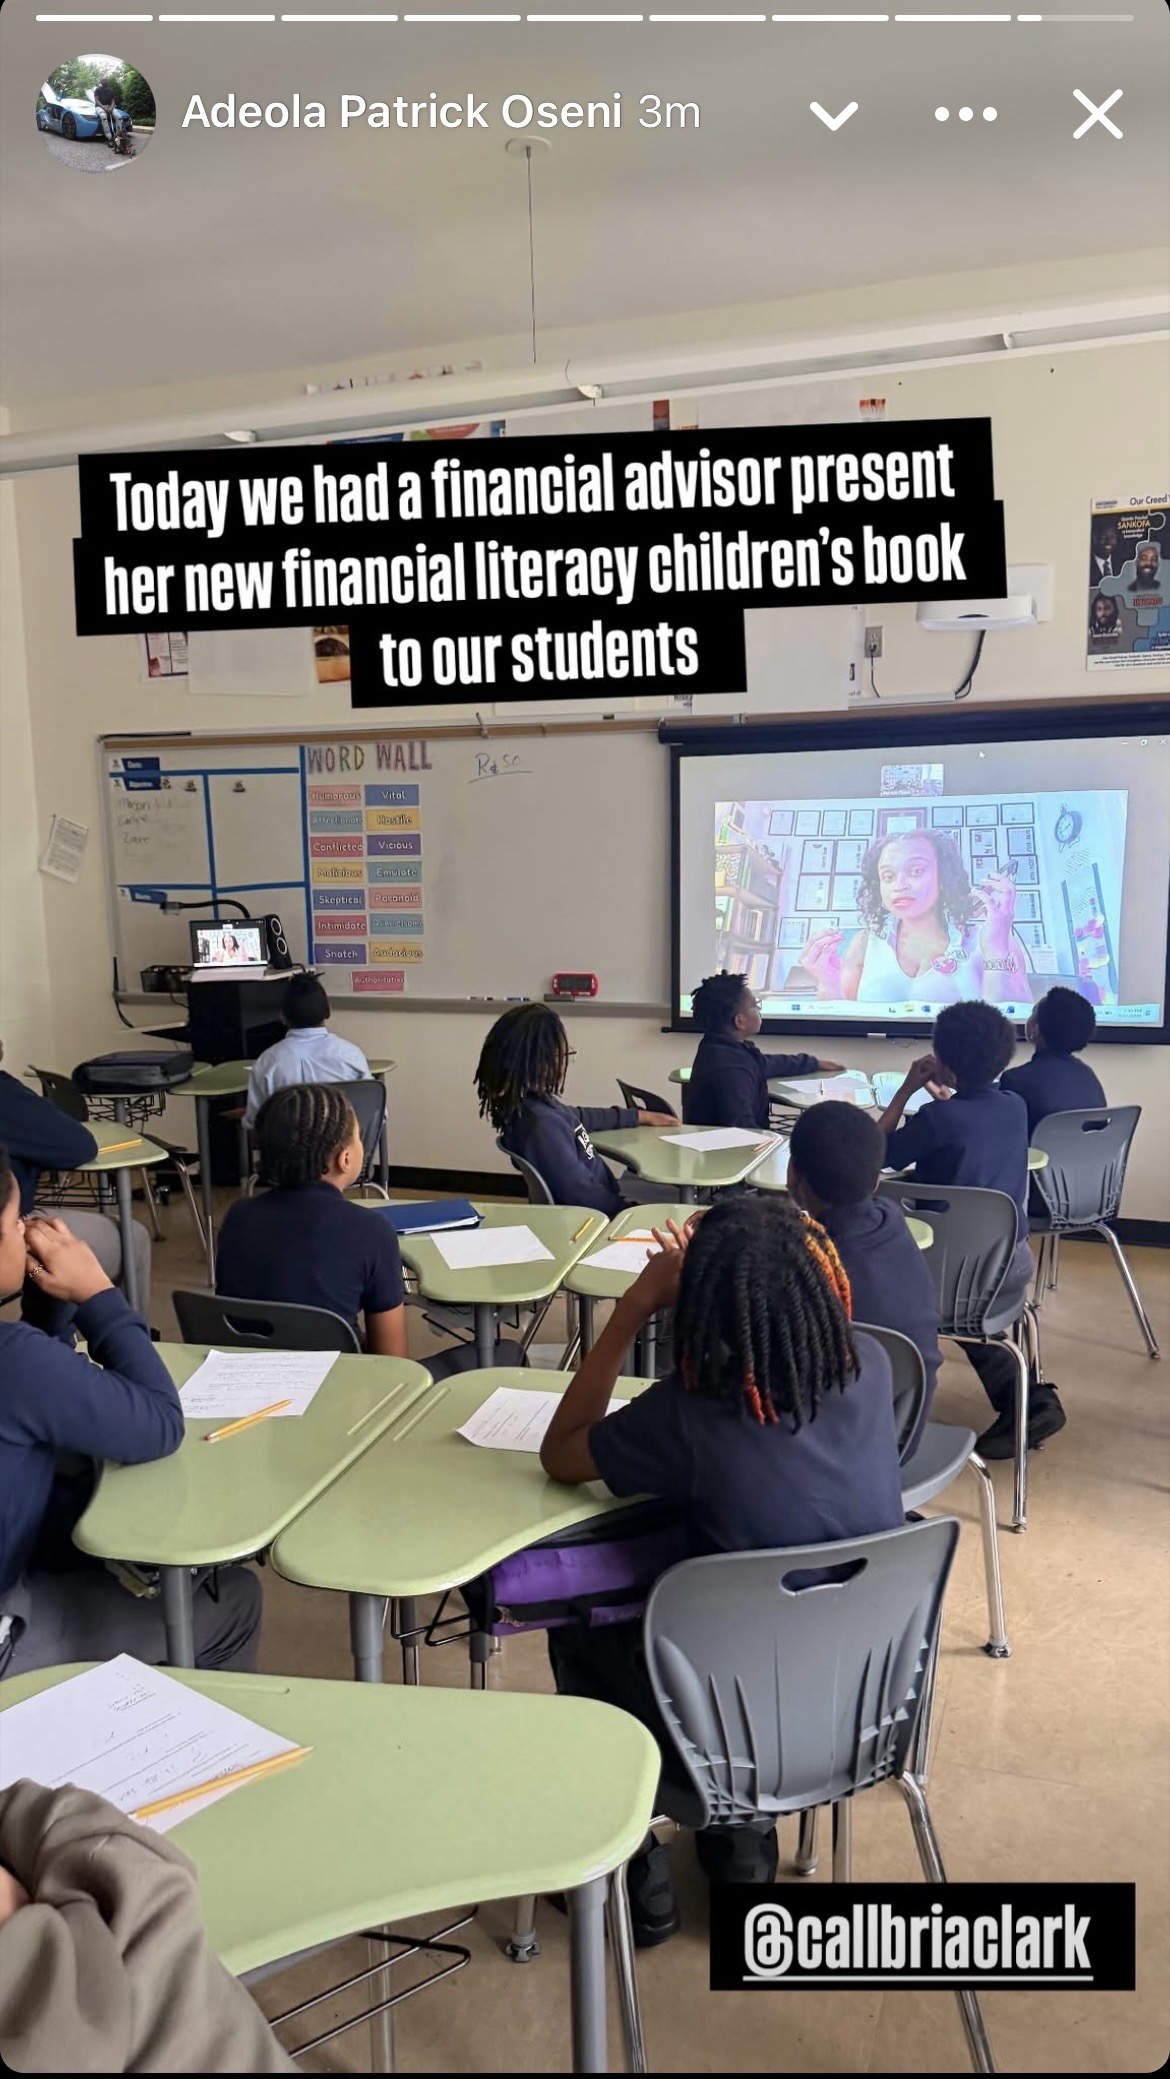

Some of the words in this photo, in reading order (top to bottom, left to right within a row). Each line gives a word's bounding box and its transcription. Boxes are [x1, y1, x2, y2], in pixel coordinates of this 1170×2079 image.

[1130, 497, 1144, 506] Our
[1146, 493, 1167, 505] Creed
[1117, 520, 1151, 530] SANKOFA
[308, 746, 365, 773] WORD
[375, 740, 433, 771] WALL
[381, 790, 407, 801] Vital
[377, 814, 413, 825] Hostile
[378, 840, 413, 850] Vicious
[317, 868, 363, 878] Malicious
[376, 868, 417, 878] Emulate
[319, 895, 363, 906] Skeptical
[375, 893, 419, 903] Paranoid
[318, 921, 366, 931] Intimidate
[325, 949, 358, 959] Snatch
